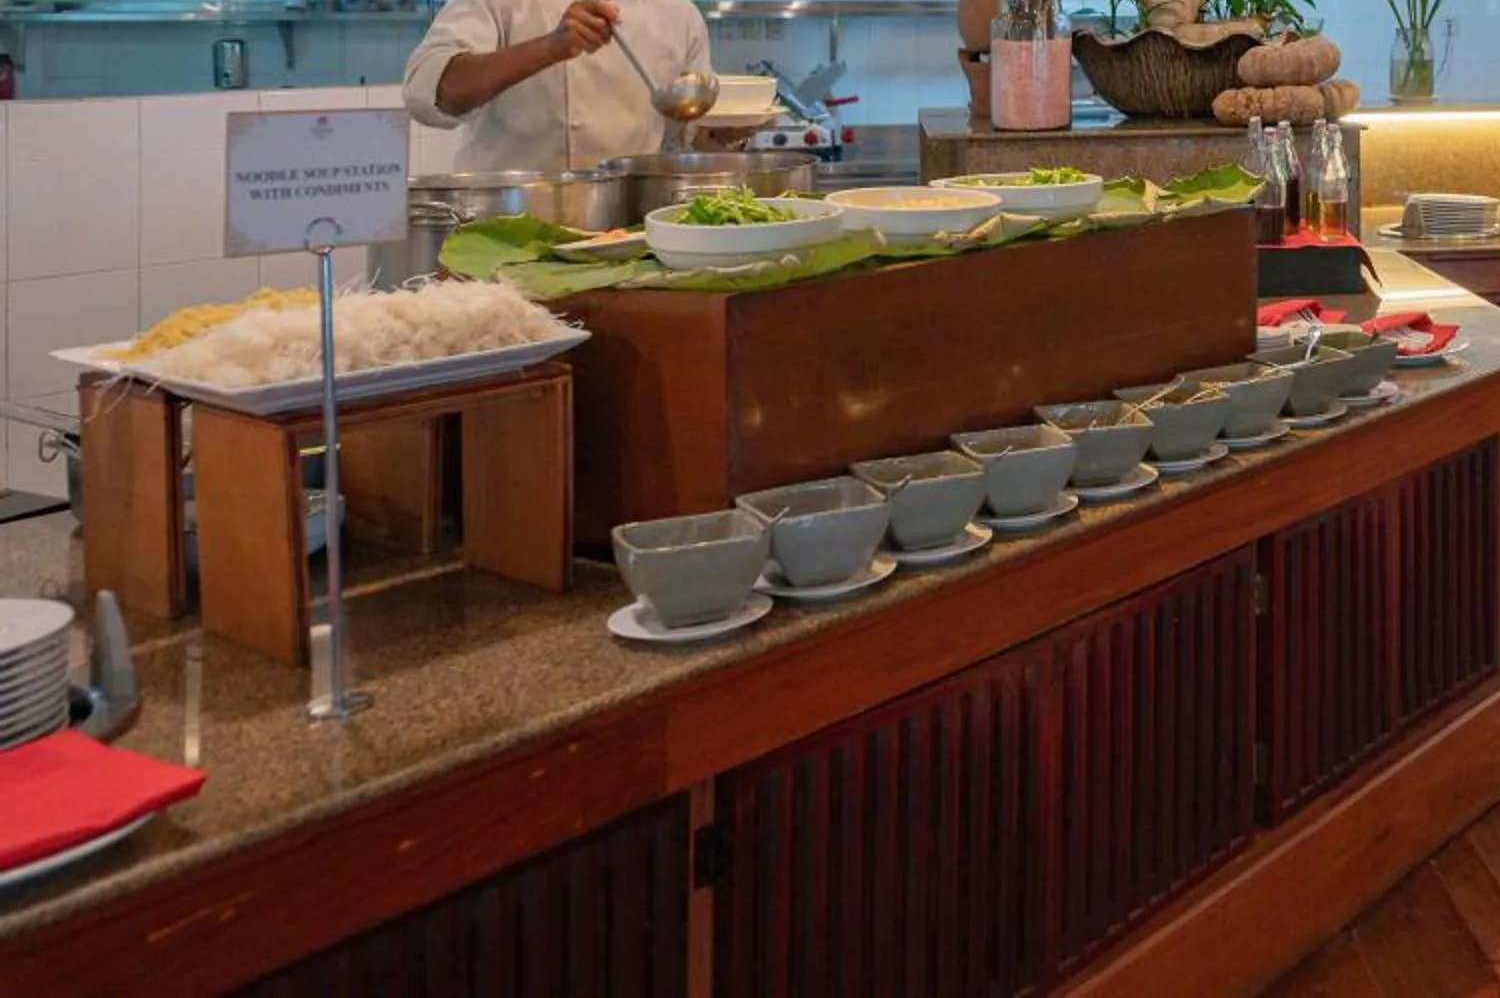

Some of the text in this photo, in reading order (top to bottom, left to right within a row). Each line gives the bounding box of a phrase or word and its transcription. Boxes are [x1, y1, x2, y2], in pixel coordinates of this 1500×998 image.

[235, 162, 401, 183] NOODLE SOUP STATION
[249, 180, 391, 201] WITH CONDIMENTS
